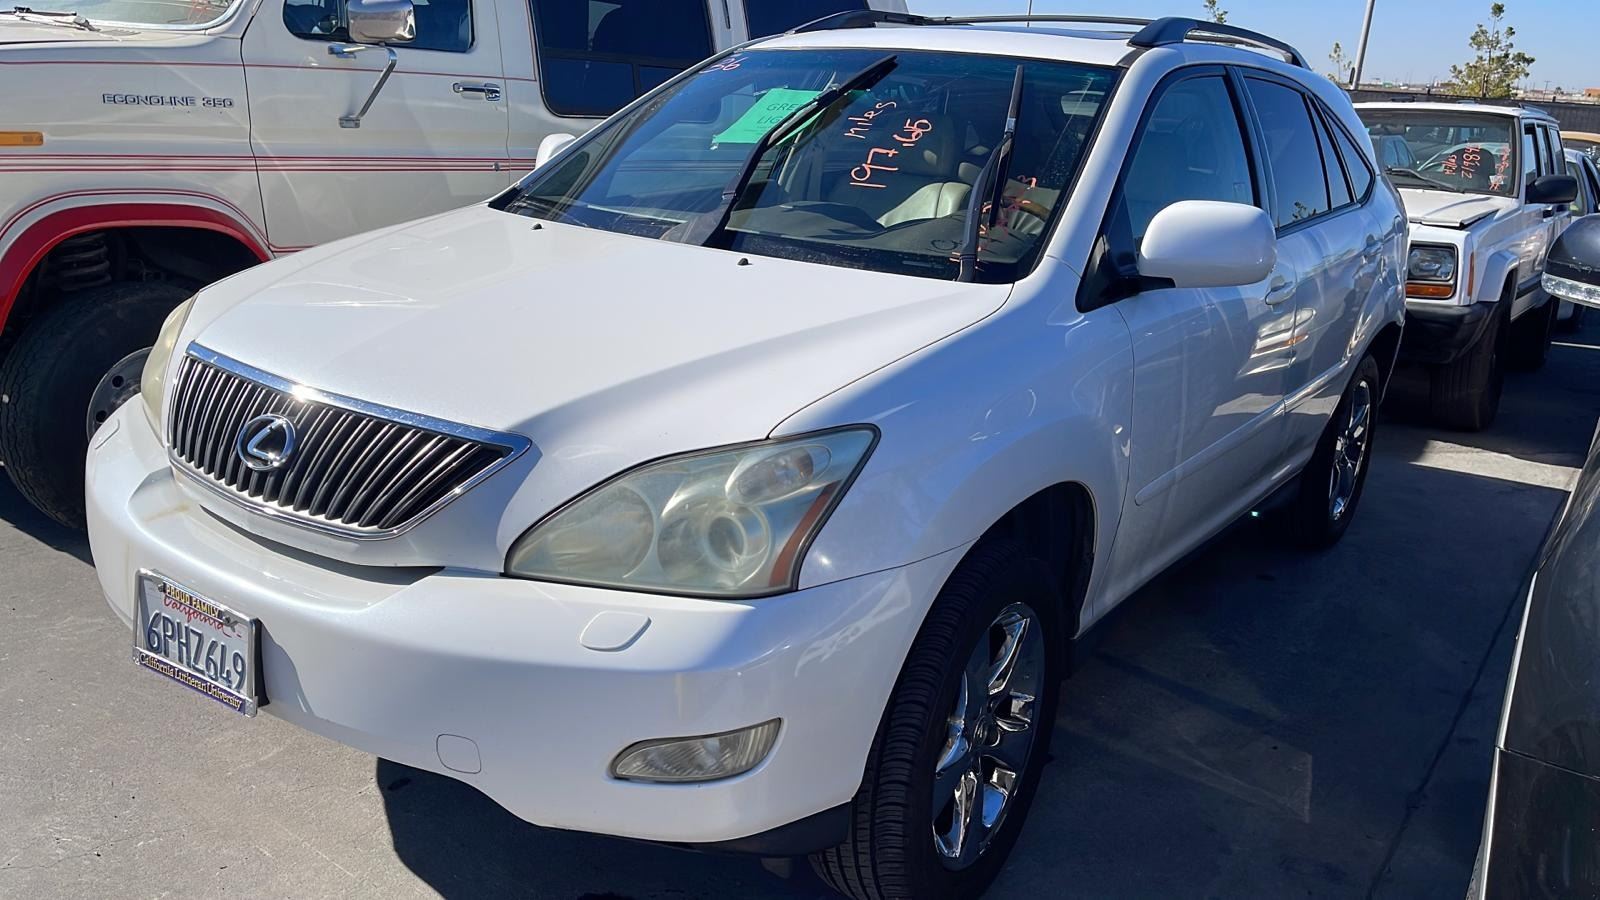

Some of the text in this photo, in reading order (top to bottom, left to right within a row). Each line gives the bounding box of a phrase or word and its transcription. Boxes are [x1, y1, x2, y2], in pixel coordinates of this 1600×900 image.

[102, 93, 235, 108] ECONOLINE 350
[163, 595, 231, 638] California
[166, 585, 220, 618] PROUD FAMILY
[147, 611, 247, 692] 6PHZ649
[140, 653, 242, 710] California Lutheran University
